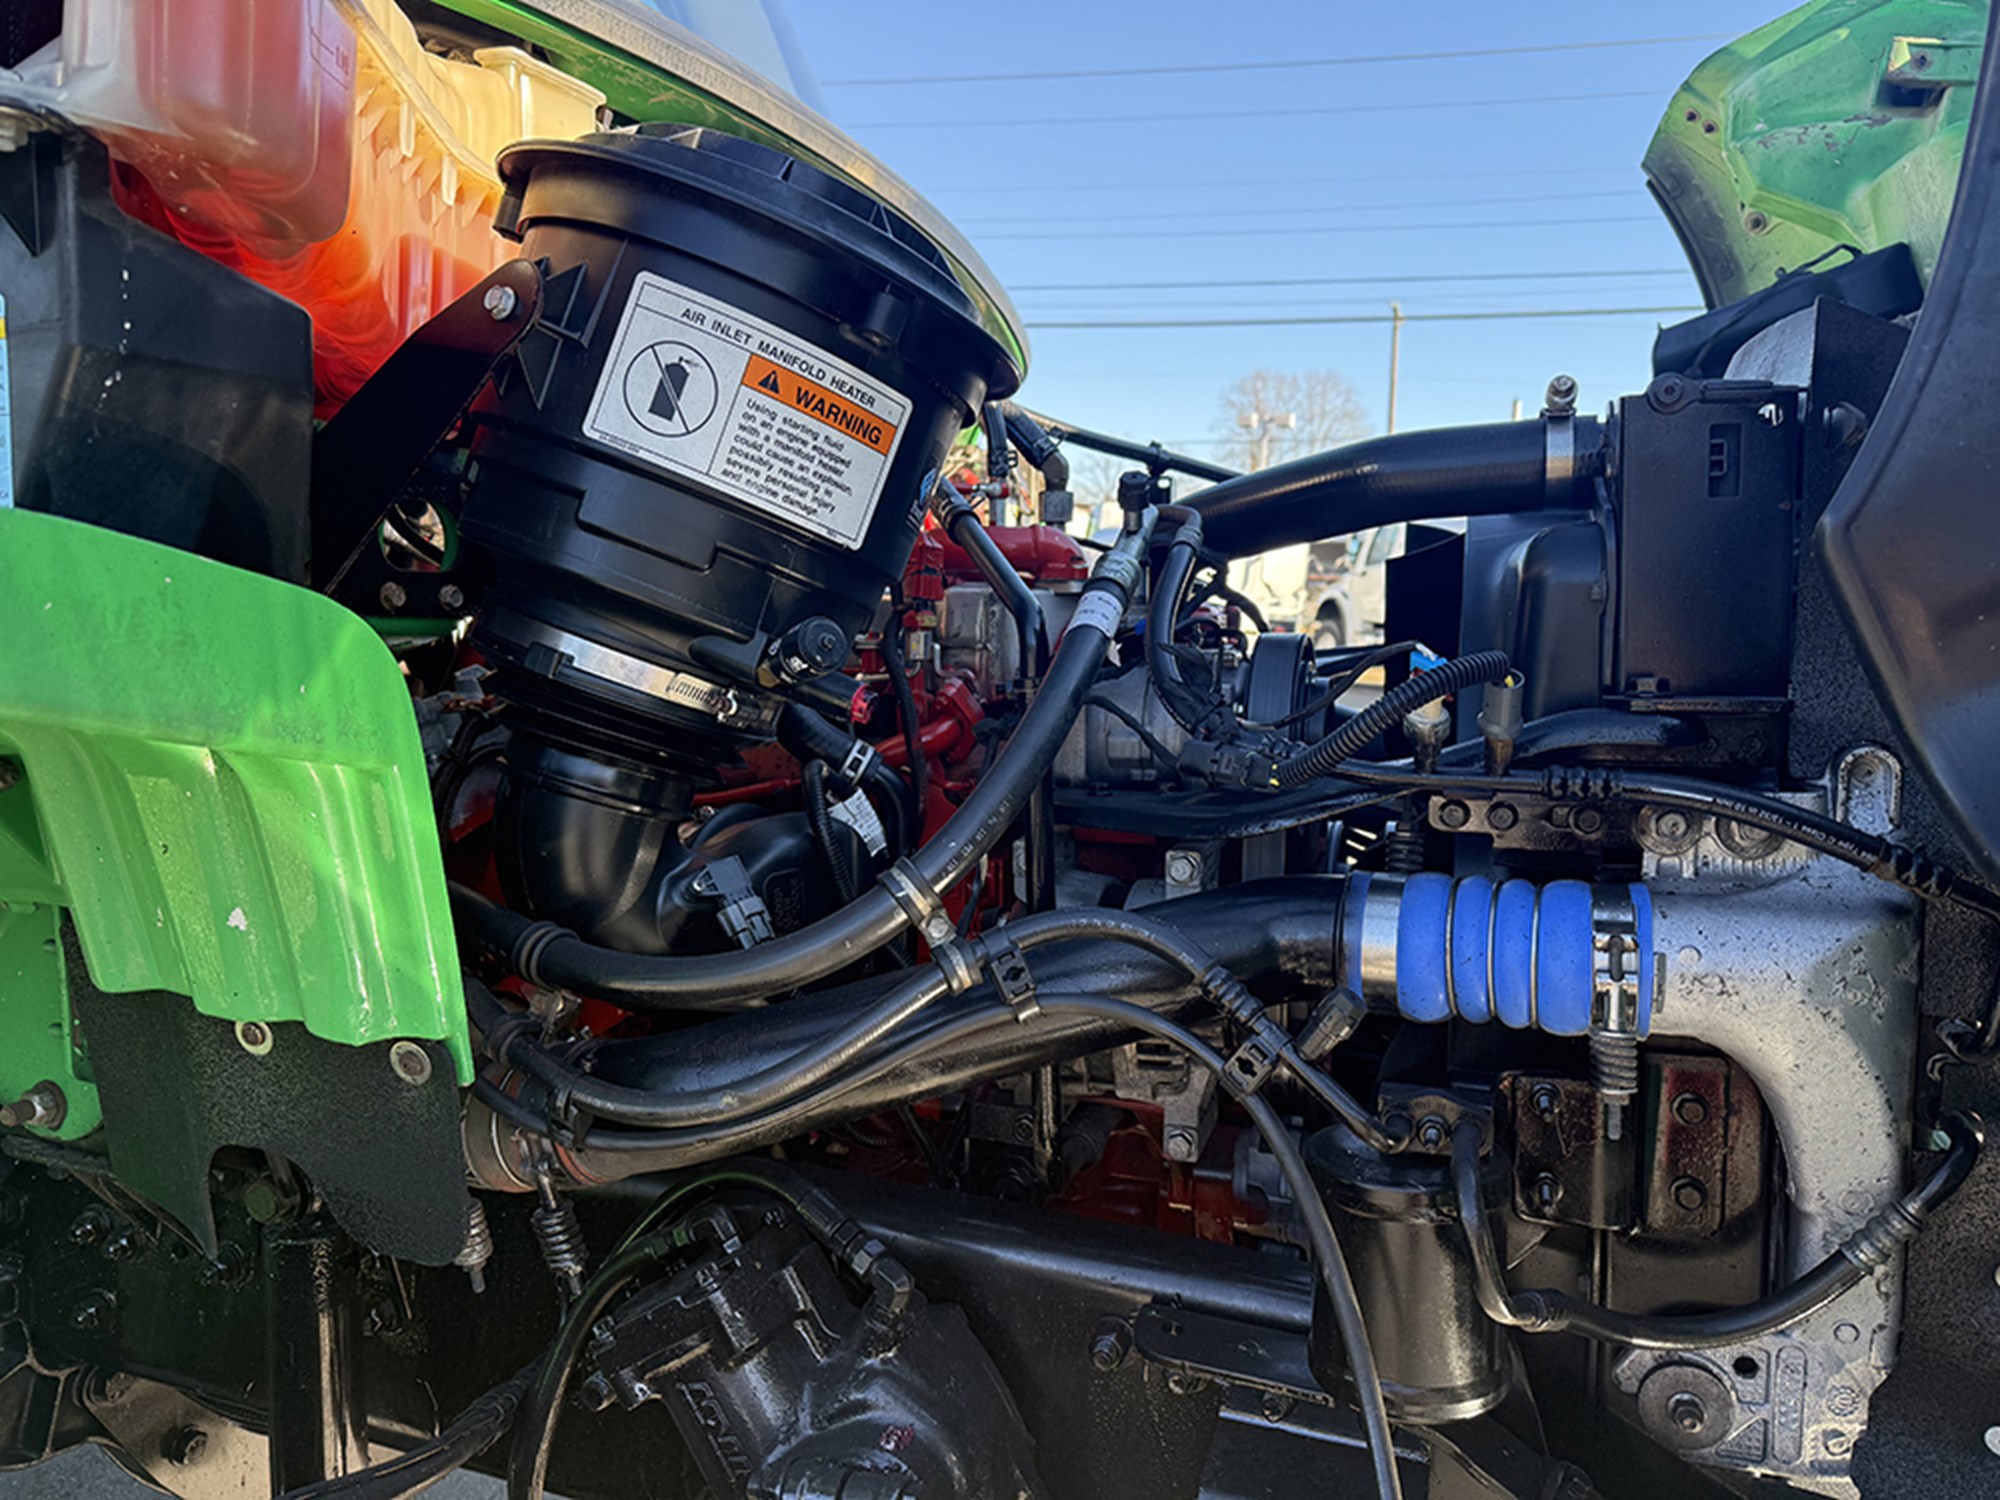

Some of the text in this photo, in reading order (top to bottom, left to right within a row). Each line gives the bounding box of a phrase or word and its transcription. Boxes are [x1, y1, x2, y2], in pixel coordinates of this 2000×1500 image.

[681, 307, 876, 409] AIR INLET MANIFOLD HEATER
[742, 411, 852, 469] on an engine equipped
[747, 398, 845, 452] Using starting fluid
[796, 387, 882, 445] WARNING
[729, 445, 774, 472] possibly
[778, 467, 821, 494] resulting
[733, 434, 763, 452] could
[765, 449, 795, 467] cause
[797, 463, 810, 474] an
[738, 423, 845, 477] with a manifold heater
[721, 468, 743, 482] and
[745, 478, 779, 499] engine
[726, 457, 835, 514] severe personal injury
[1802, 826, 1826, 840] Class
[1826, 834, 1836, 844] C
